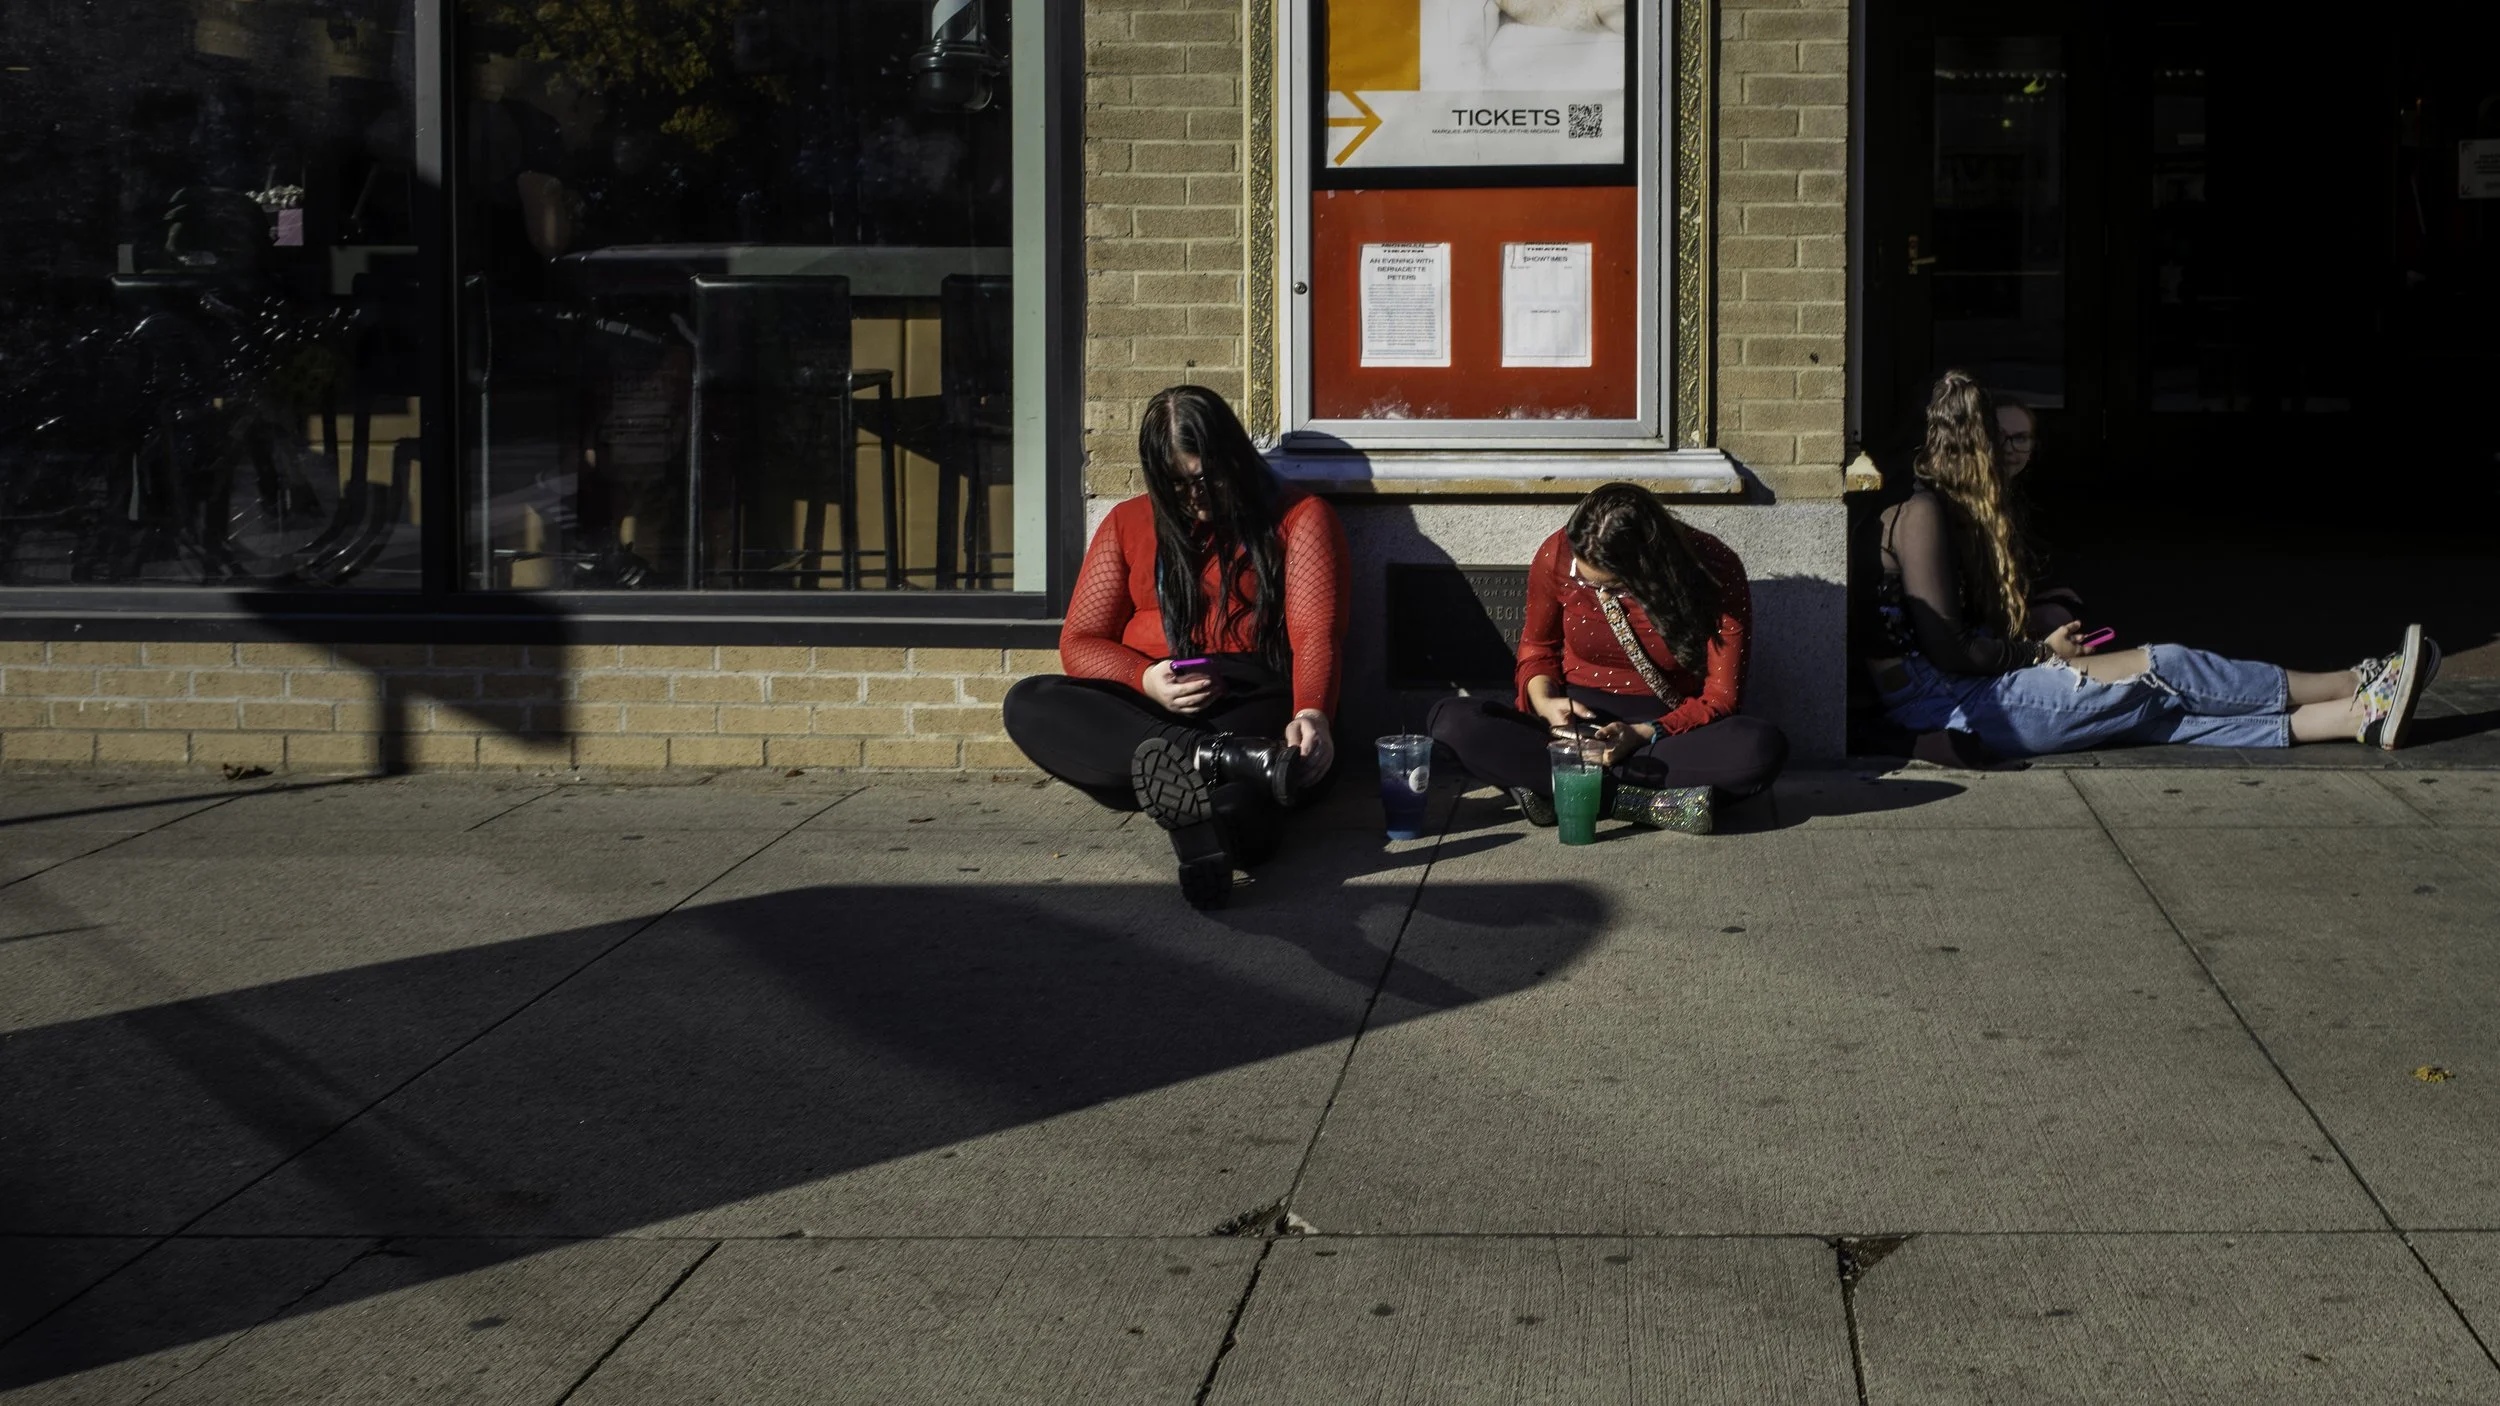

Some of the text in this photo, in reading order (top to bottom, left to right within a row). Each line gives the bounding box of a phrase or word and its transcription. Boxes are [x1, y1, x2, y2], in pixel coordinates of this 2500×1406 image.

[1451, 109, 1560, 126] TICKETS
[1523, 255, 1568, 263] SHOWTIMES
[1486, 605, 1529, 620] REGIS
